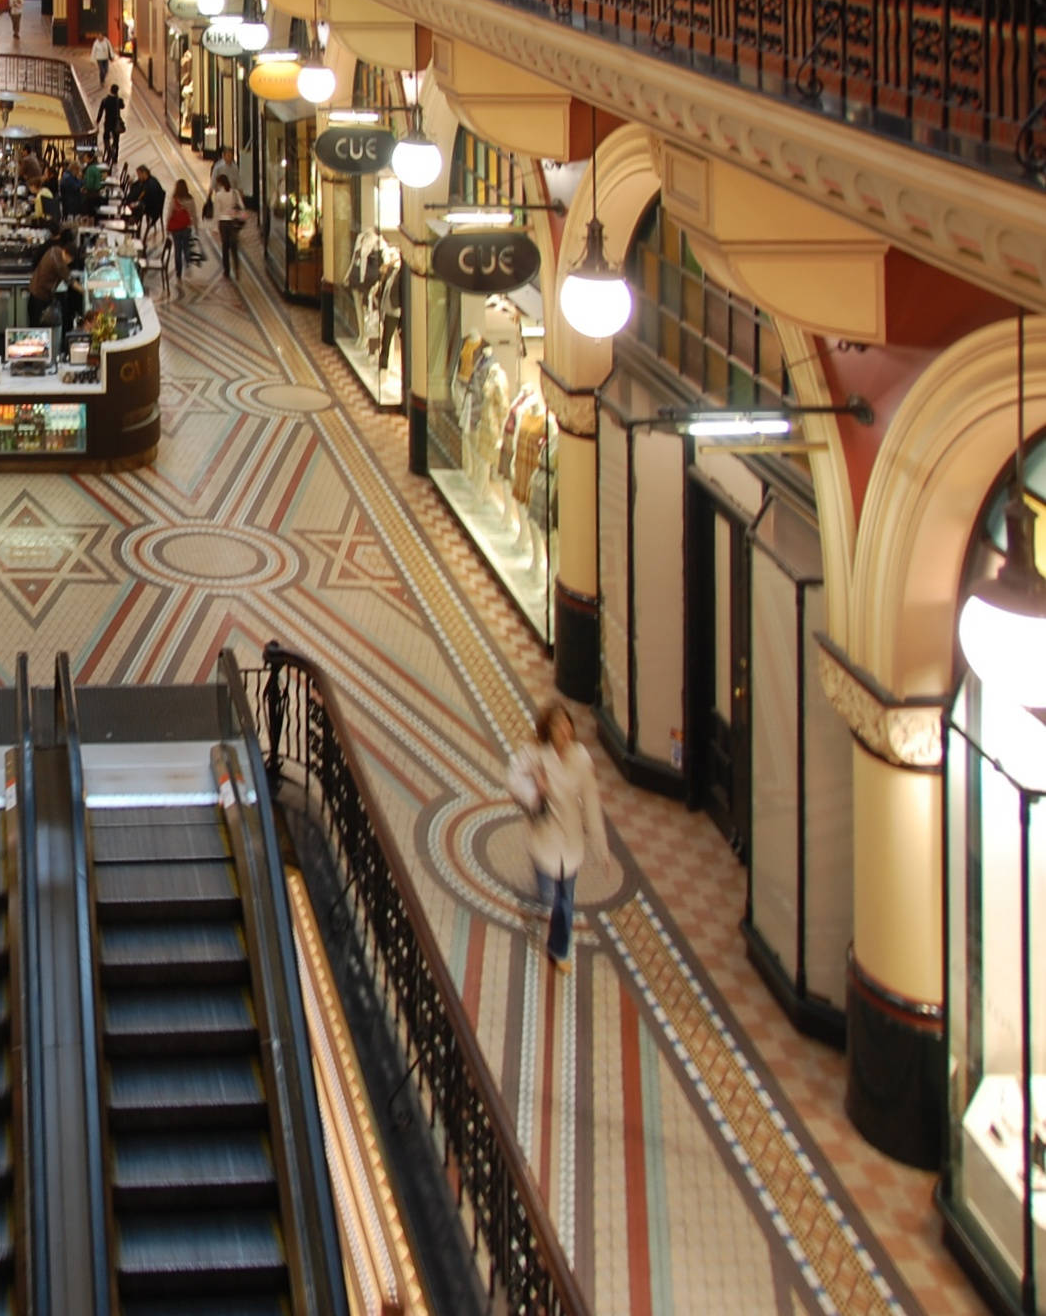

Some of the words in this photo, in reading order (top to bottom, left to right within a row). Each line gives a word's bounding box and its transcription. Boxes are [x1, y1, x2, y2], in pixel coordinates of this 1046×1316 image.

[206, 31, 240, 45] kikki.
[335, 137, 377, 160] CUE
[458, 244, 515, 275] CUE
